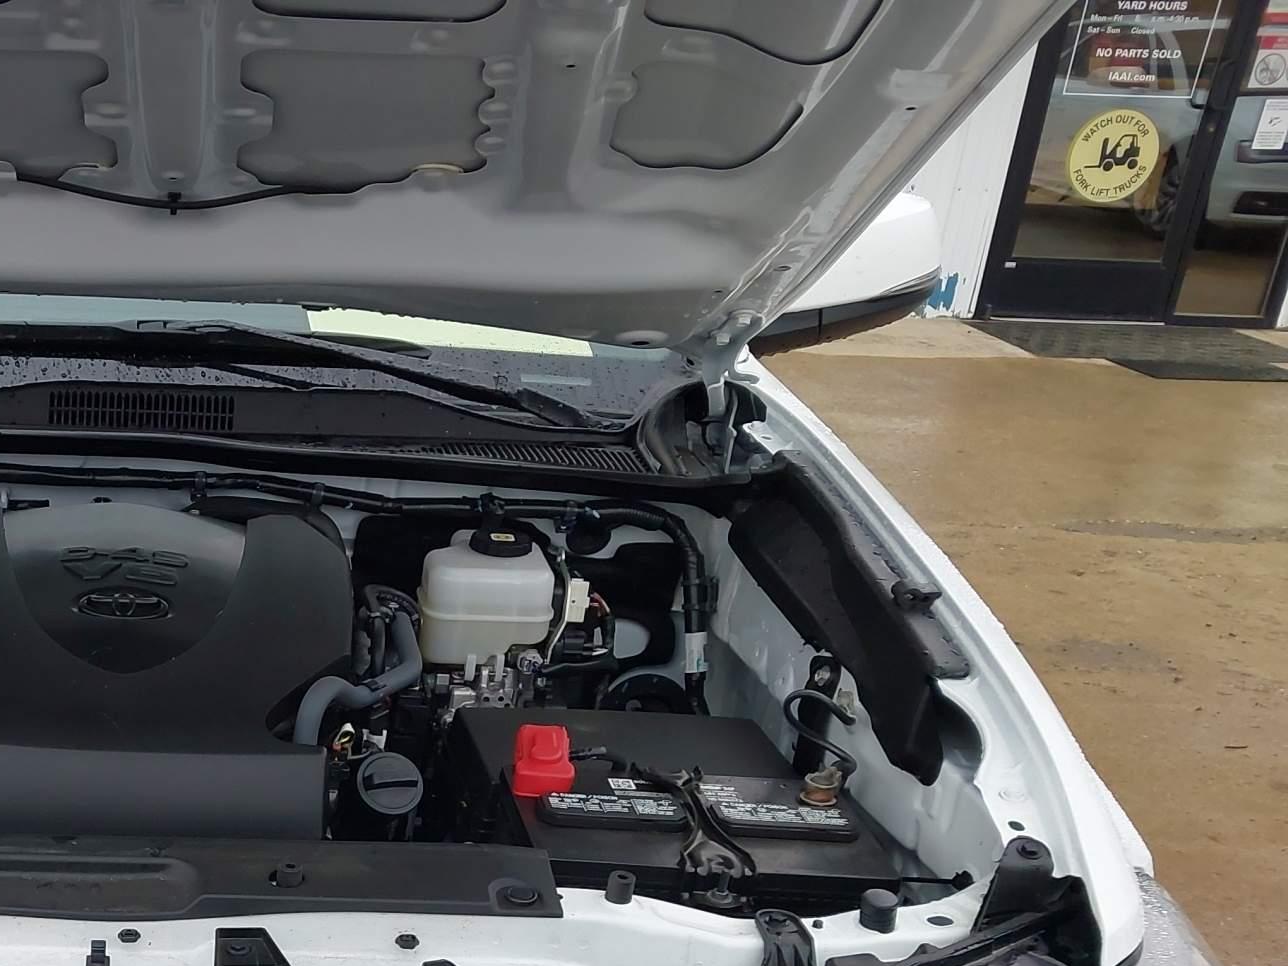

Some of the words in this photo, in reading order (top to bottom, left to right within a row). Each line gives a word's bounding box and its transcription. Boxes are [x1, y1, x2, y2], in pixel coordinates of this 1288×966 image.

[1117, 0, 1146, 10] YARD
[1148, 1, 1188, 11] HOURS
[1106, 26, 1121, 34] Sun
[1130, 26, 1156, 35] Closed
[1095, 47, 1113, 57] NO
[1114, 48, 1149, 58] PARTS
[1152, 49, 1182, 59] SOLD
[1108, 71, 1156, 82] IAAI.com
[1081, 116, 1113, 142] WATCH
[1115, 114, 1136, 125] OUT
[1133, 119, 1150, 138] FOR
[1073, 168, 1091, 192] FORK
[1090, 186, 1111, 197] LIFT
[1112, 165, 1147, 195] TRUCKS
